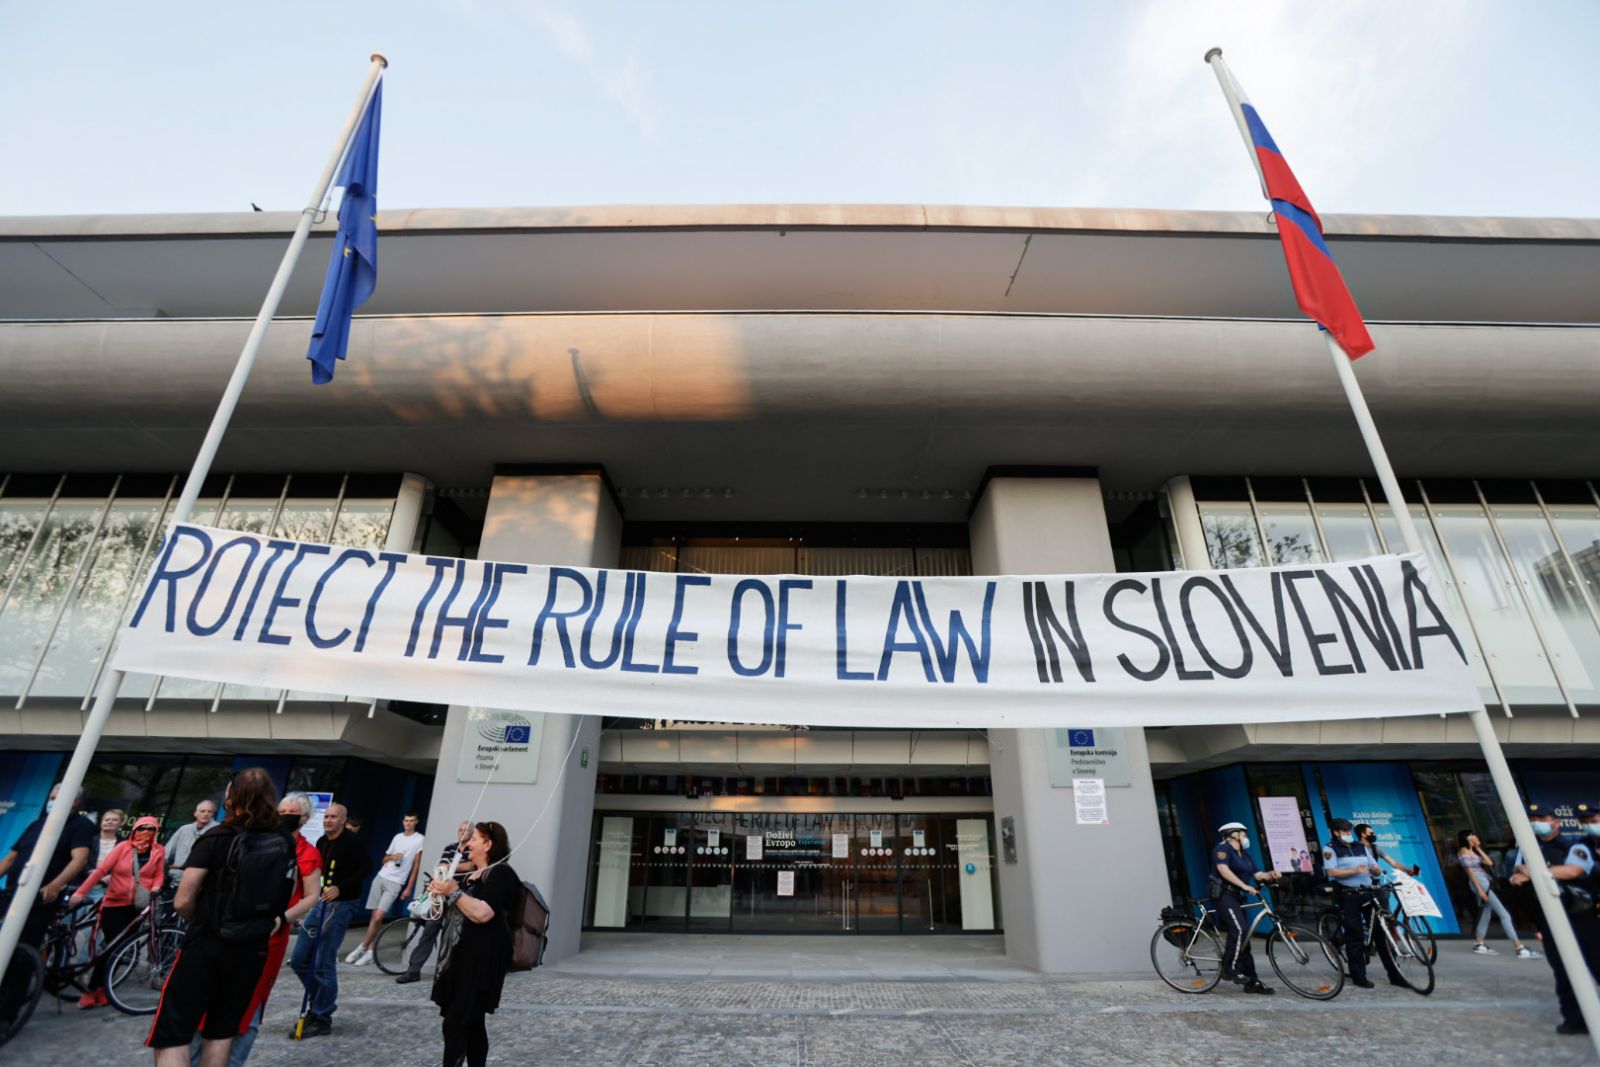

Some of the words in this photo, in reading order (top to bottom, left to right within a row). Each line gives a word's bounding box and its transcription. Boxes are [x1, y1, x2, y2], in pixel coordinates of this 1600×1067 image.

[129, 525, 408, 653] ROTECT
[404, 557, 527, 664] THE
[527, 567, 712, 675] RULE
[727, 578, 813, 679] OF
[836, 579, 997, 683] LAW
[1022, 580, 1096, 683] IN
[1102, 559, 1469, 682] SLOVENIA
[765, 839, 796, 848] Evropo
